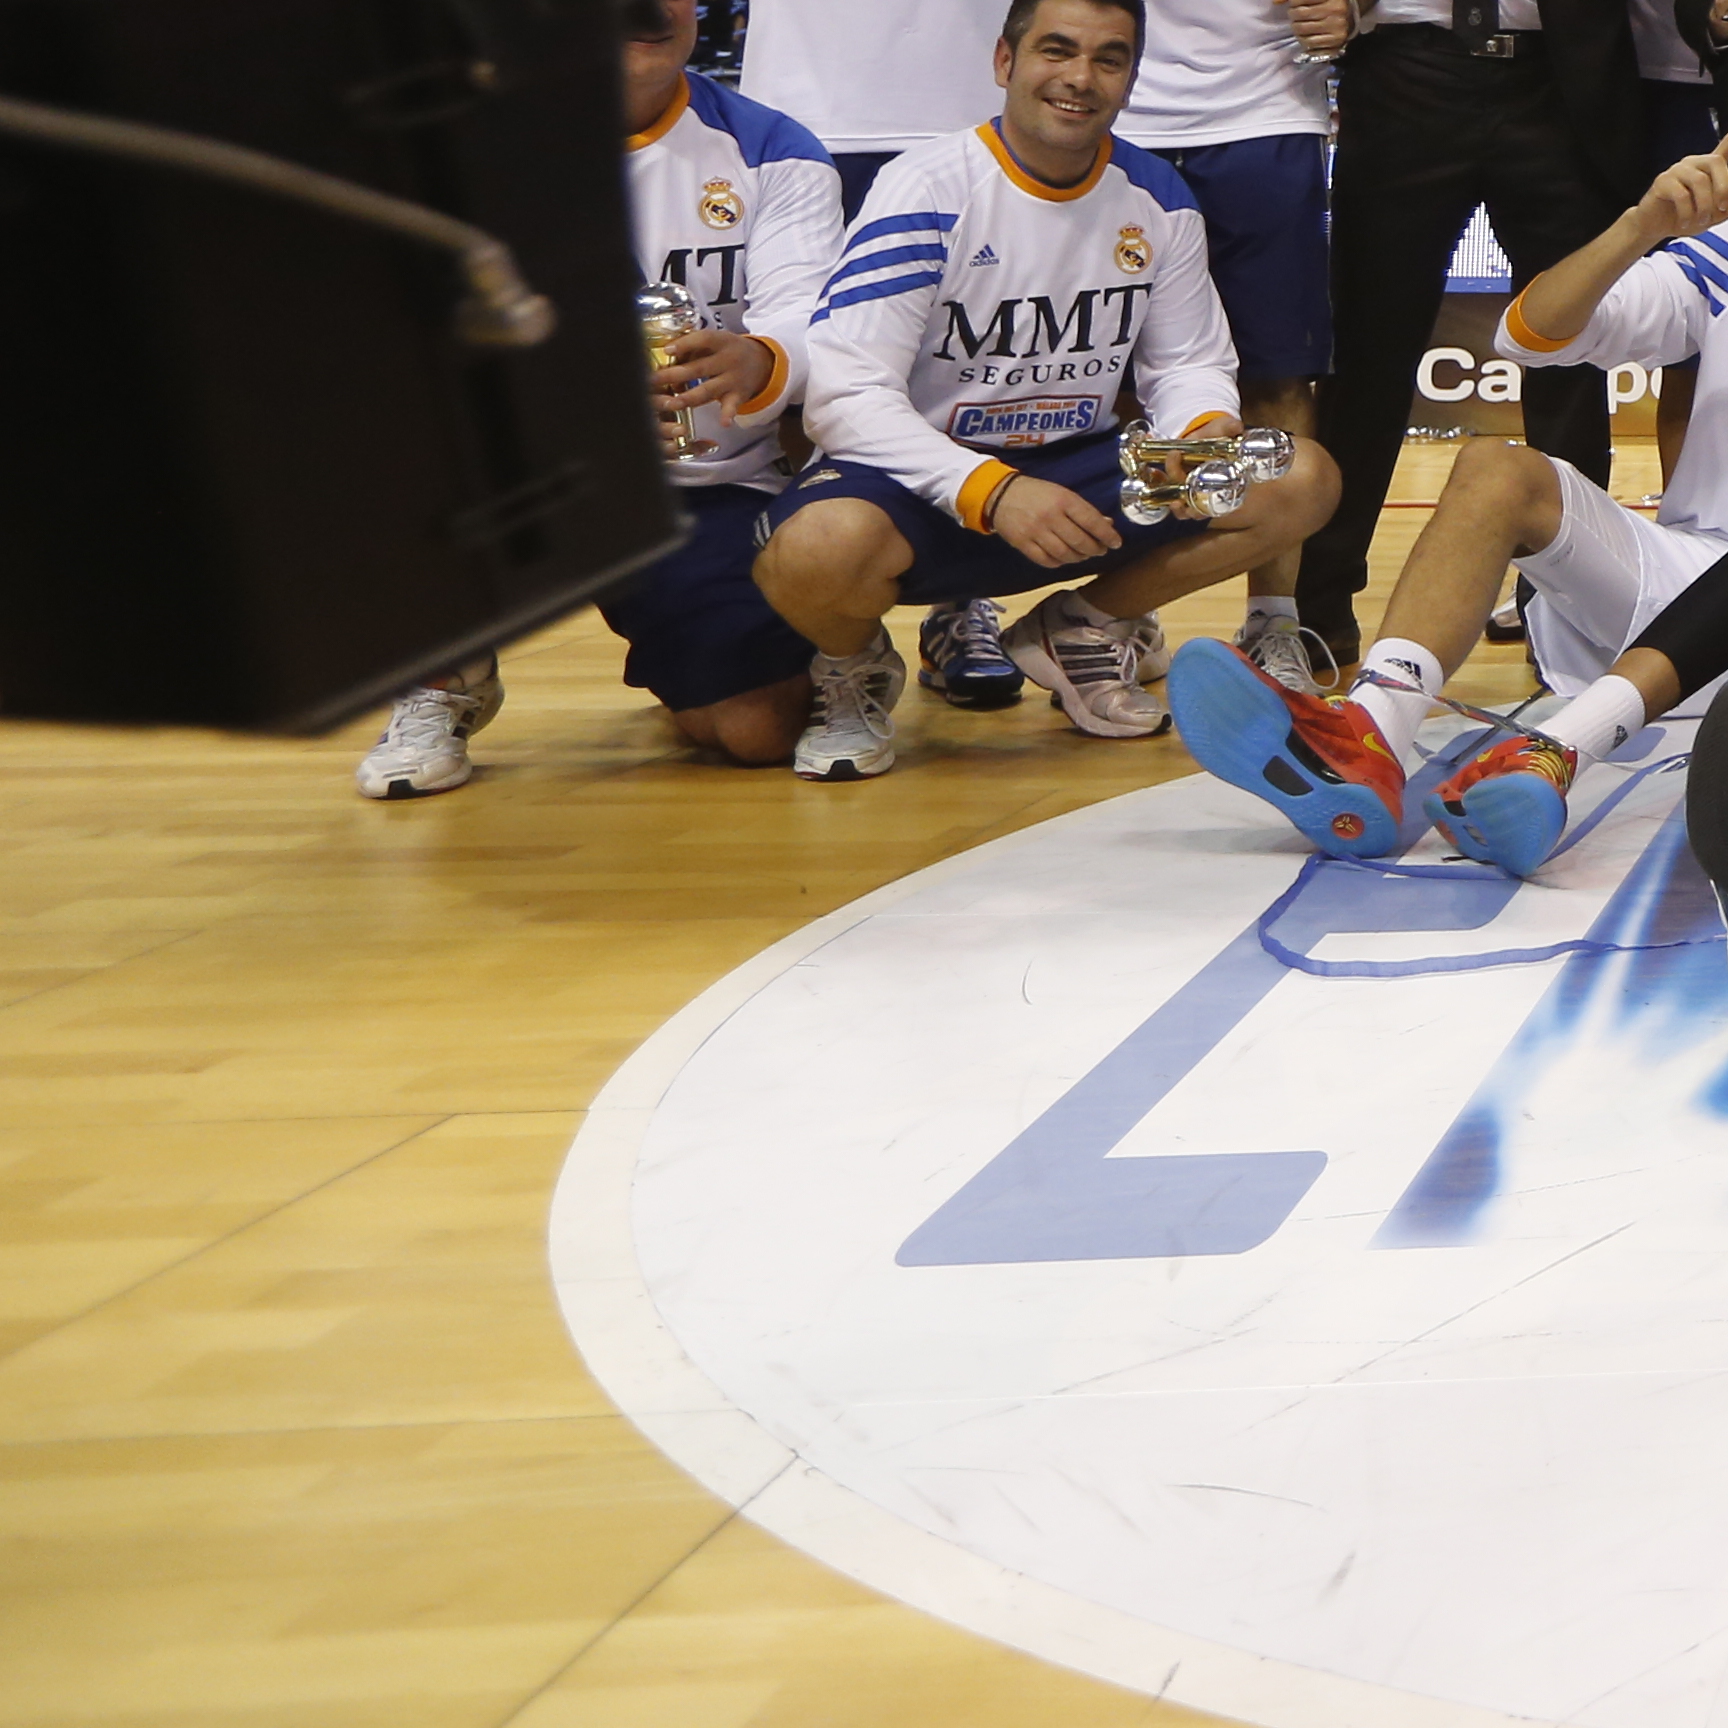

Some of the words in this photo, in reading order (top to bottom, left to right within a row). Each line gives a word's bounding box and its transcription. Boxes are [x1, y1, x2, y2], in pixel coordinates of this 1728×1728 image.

[969, 256, 1000, 268] adidas
[933, 283, 1153, 361] MMT
[958, 355, 1121, 386] SEGUROS
[956, 400, 1094, 437] CAMPEONES
[1004, 433, 1045, 448] 24
